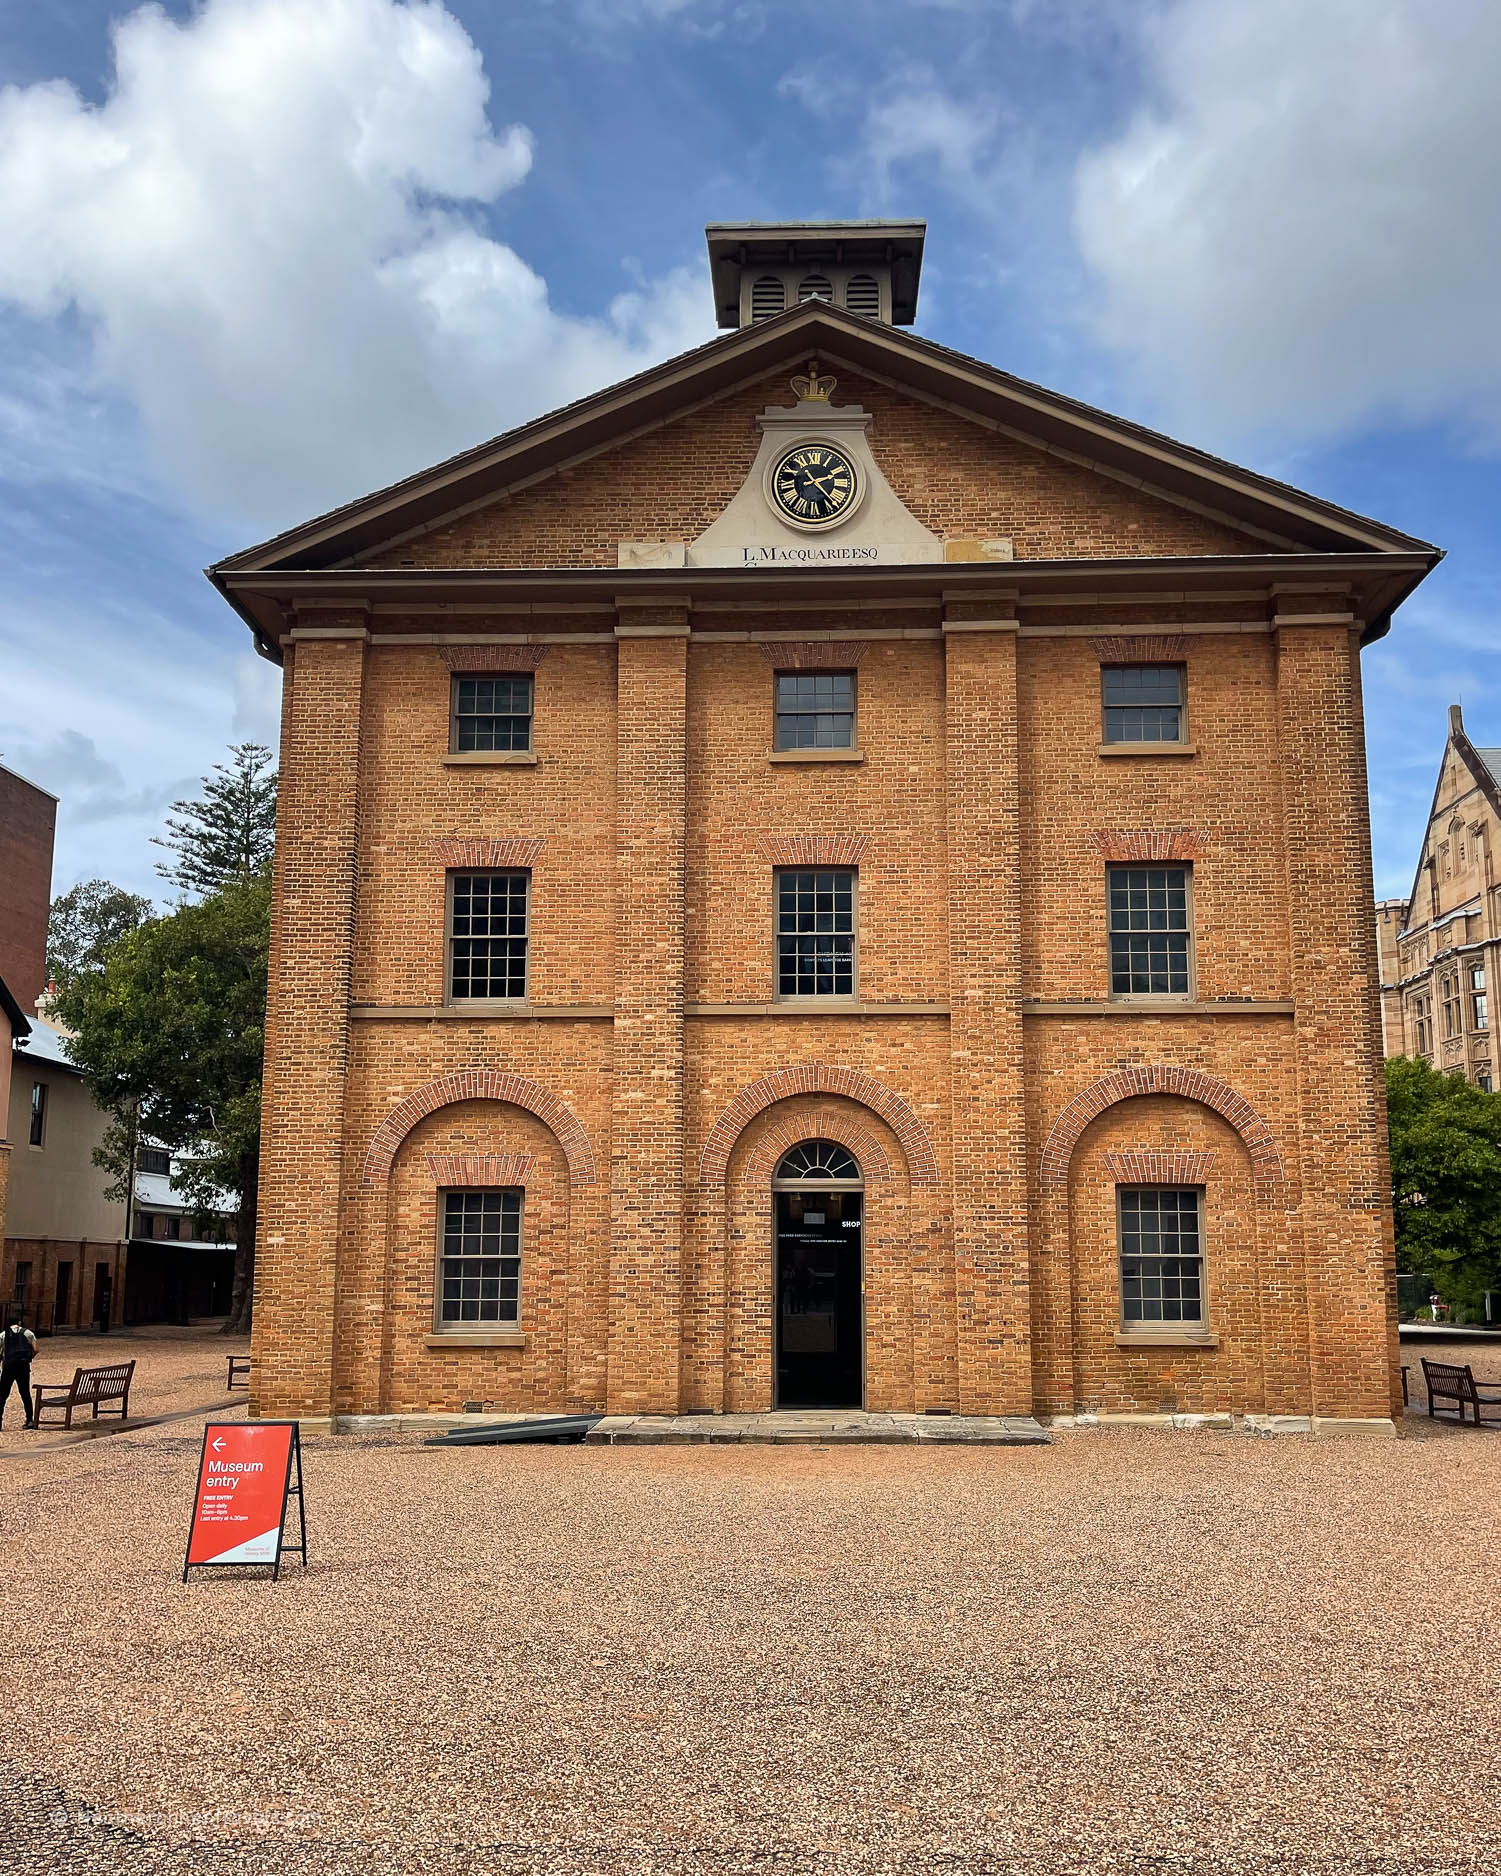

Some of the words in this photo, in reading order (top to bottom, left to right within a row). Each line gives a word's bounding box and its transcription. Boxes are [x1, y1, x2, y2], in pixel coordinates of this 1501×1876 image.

[794, 456, 808, 468] XI
[808, 453, 821, 464] XII
[784, 466, 798, 476] X
[208, 1461, 263, 1472] Museum
[206, 1476, 239, 1490] entry
